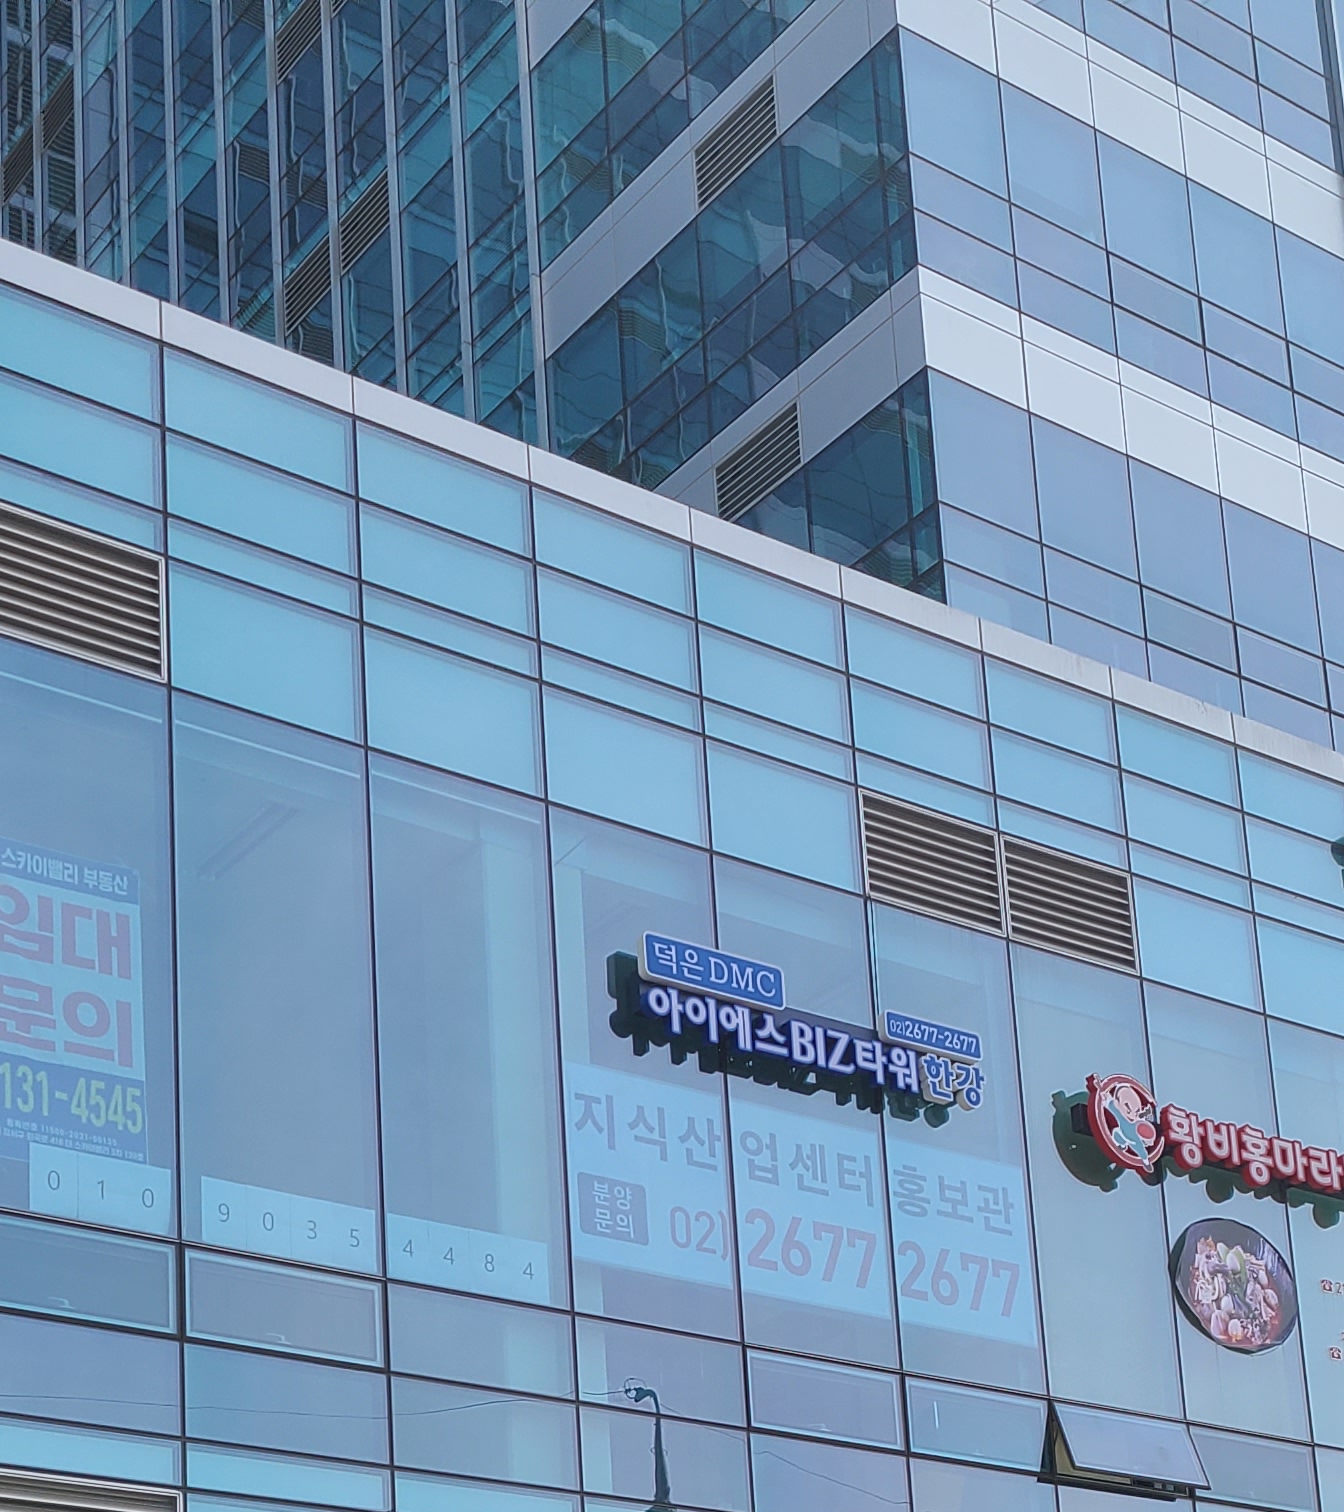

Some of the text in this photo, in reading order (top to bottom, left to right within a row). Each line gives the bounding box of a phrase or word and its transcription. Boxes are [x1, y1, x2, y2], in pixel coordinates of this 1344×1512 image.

[0, 844, 80, 886] 스카이밸리
[81, 866, 130, 897] 부동산
[922, 1053, 986, 1112] 한강
[574, 1091, 1016, 1237] 지식산업센터 홍보관
[590, 1179, 634, 1210] 분양
[593, 1206, 635, 1240] 문의
[744, 1207, 877, 1290] 2677
[898, 1240, 1021, 1318] 2677
